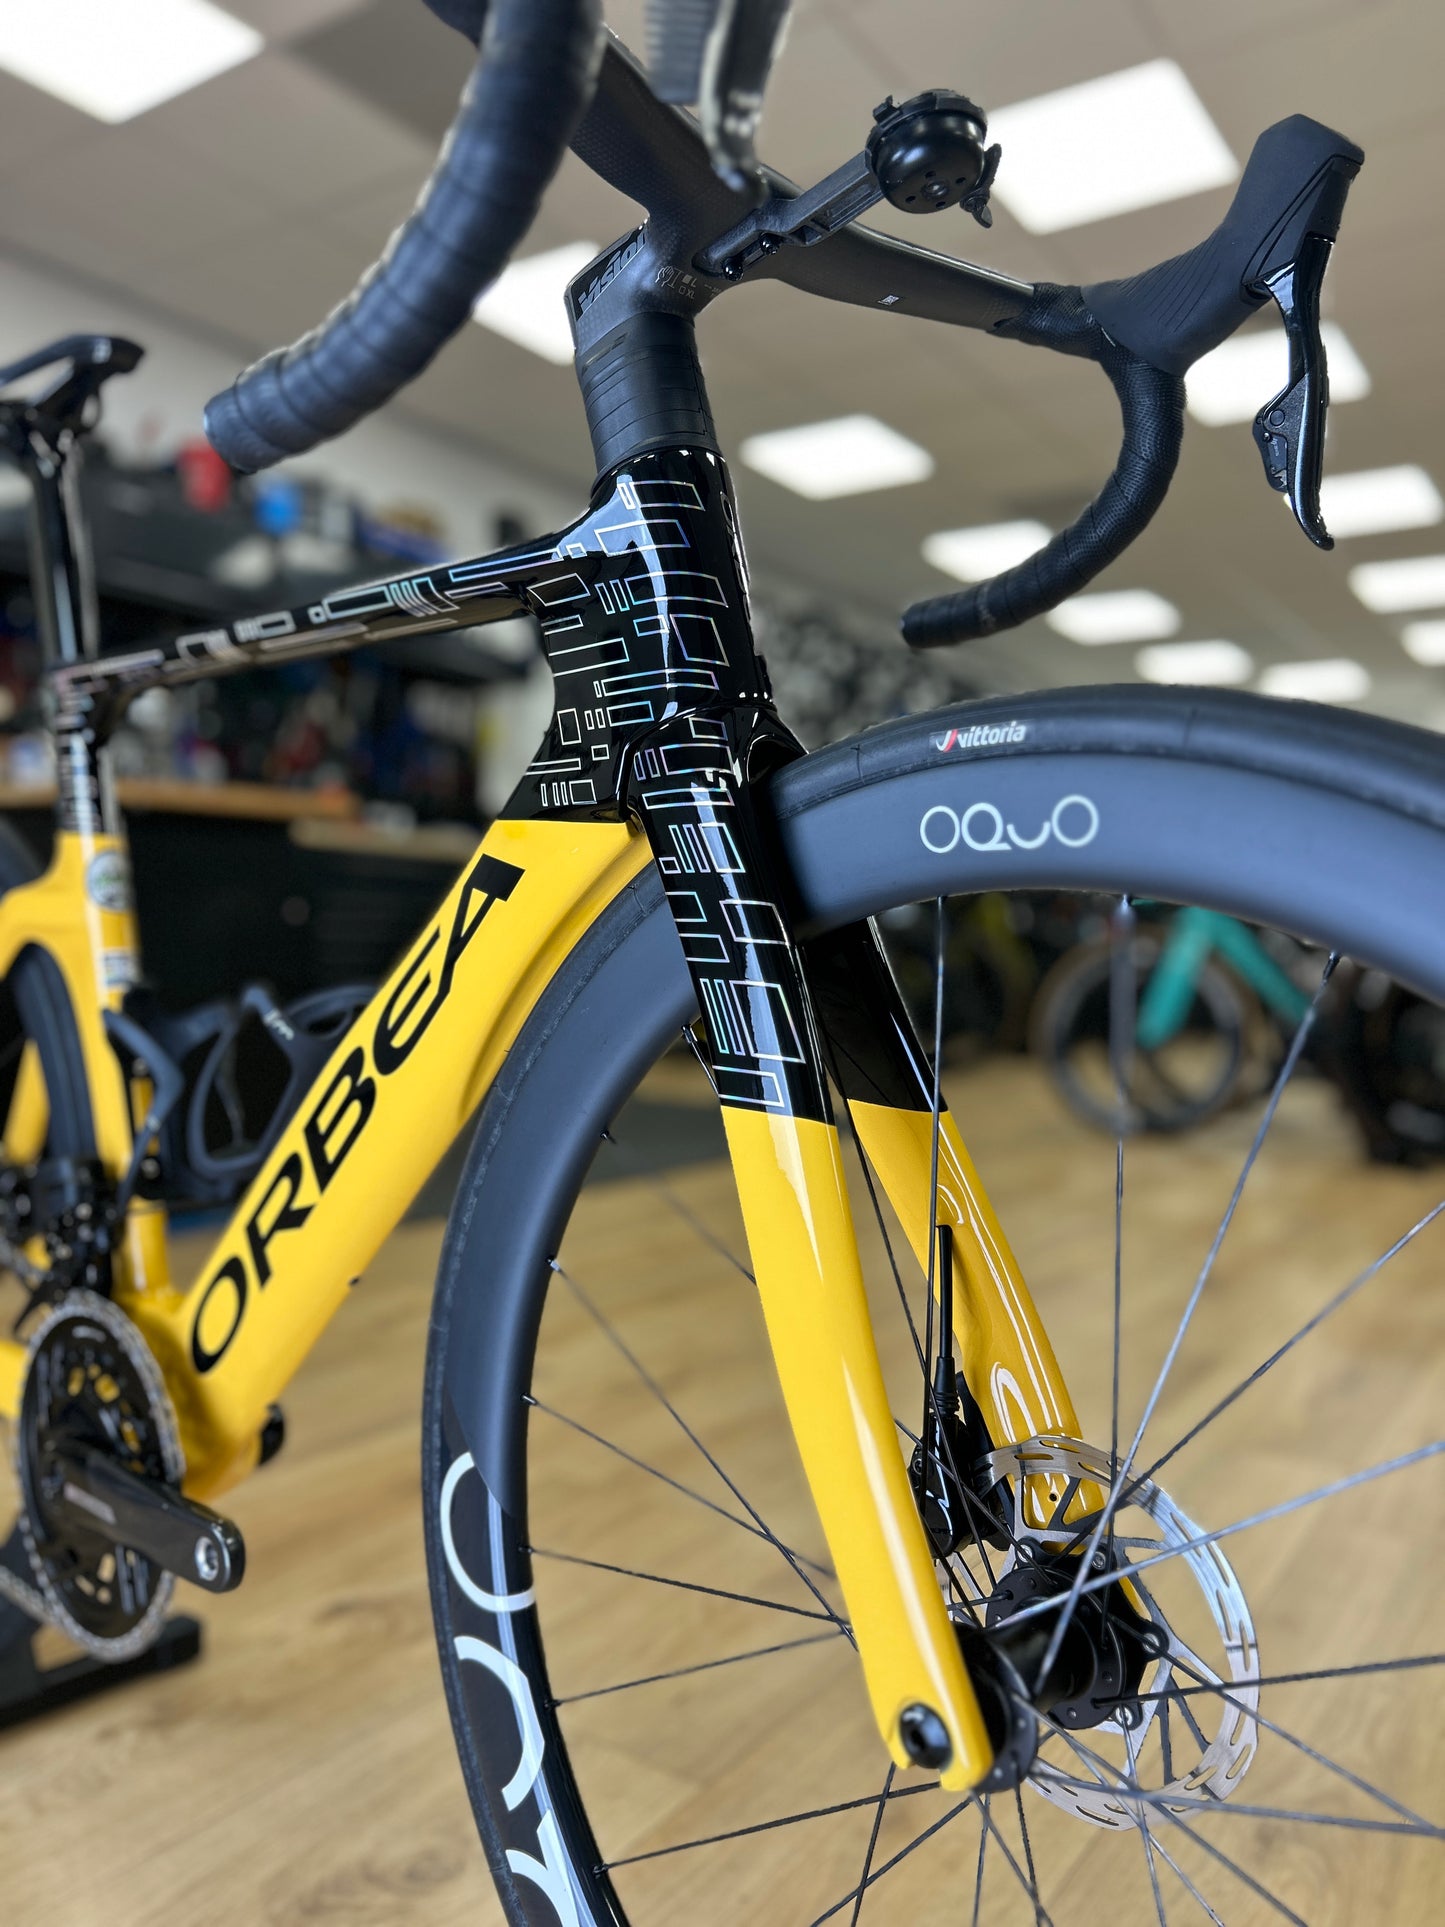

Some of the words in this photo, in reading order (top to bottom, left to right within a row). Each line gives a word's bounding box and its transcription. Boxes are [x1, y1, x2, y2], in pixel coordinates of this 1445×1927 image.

[957, 720, 1027, 749] vittoria
[919, 794, 1099, 854] OQUO
[192, 853, 526, 1375] ORBEA
